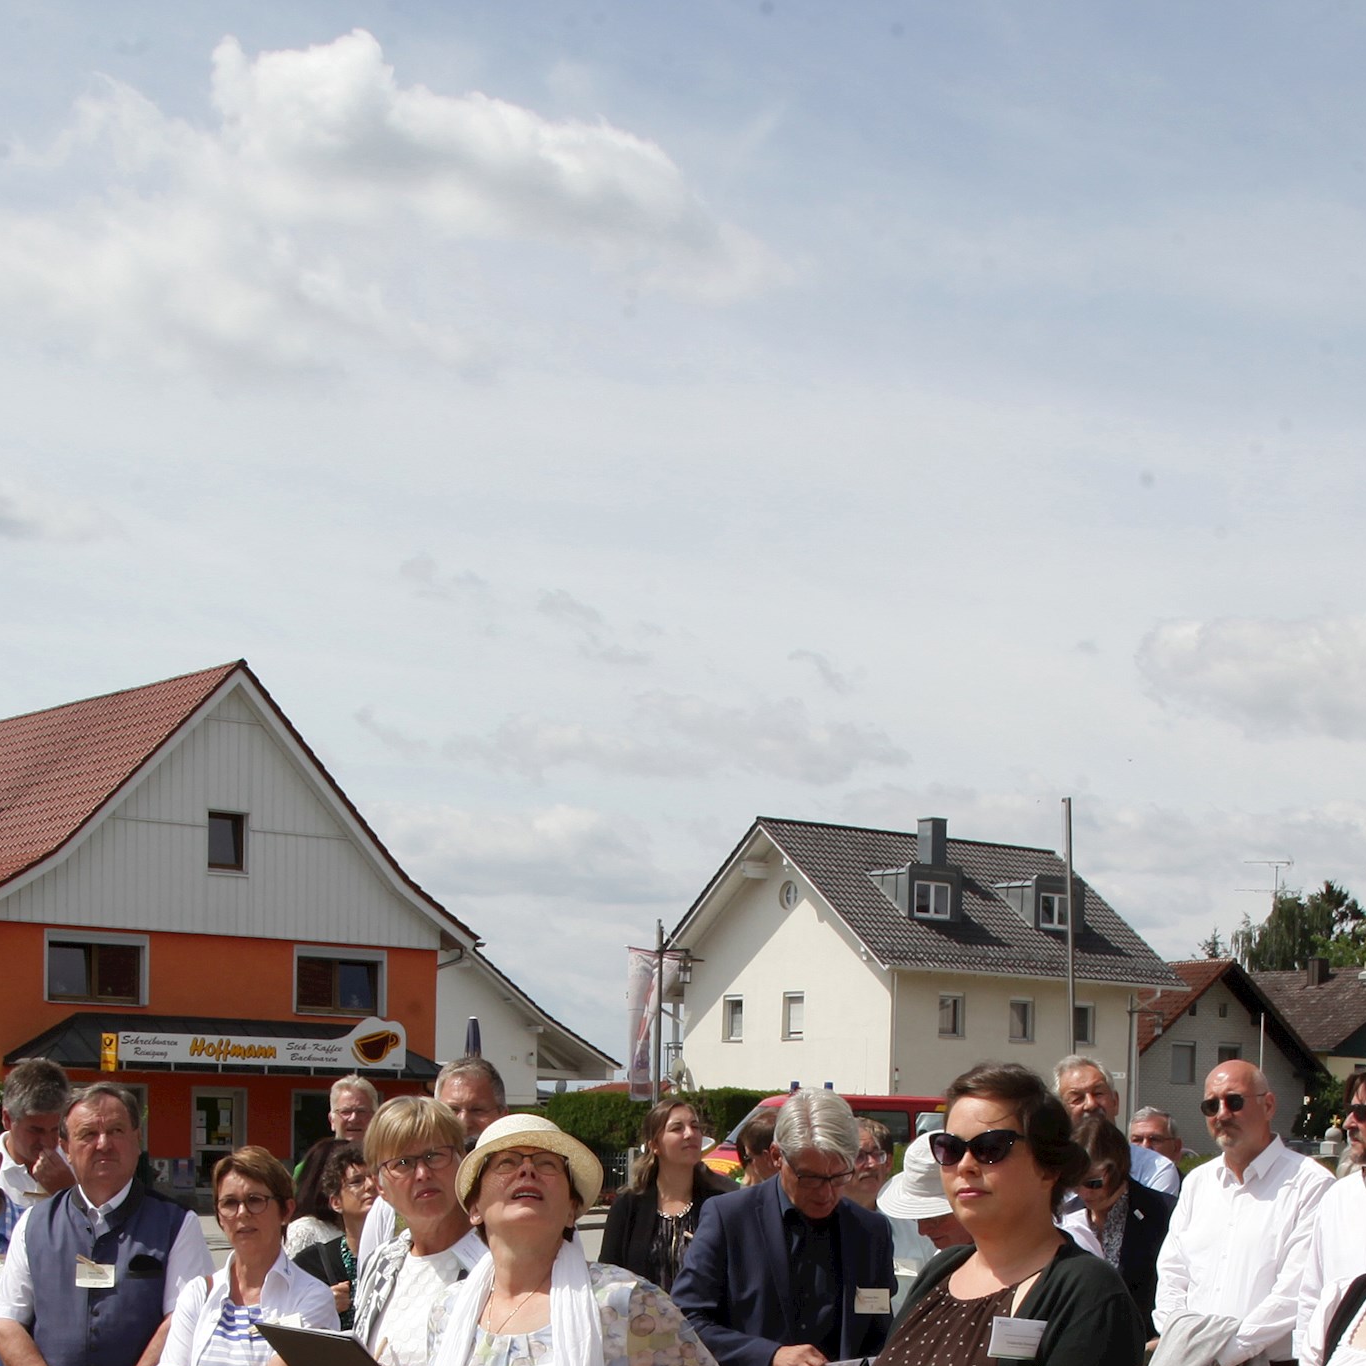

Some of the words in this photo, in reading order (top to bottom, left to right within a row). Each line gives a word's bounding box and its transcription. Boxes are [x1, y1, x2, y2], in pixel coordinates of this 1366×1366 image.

[121, 1035, 178, 1046] Schreibwaren
[133, 1047, 168, 1059] Reinigung
[189, 1037, 277, 1062] Hoffmann
[285, 1042, 343, 1054] Steh-Kaffee
[290, 1053, 338, 1063] Backwaren
